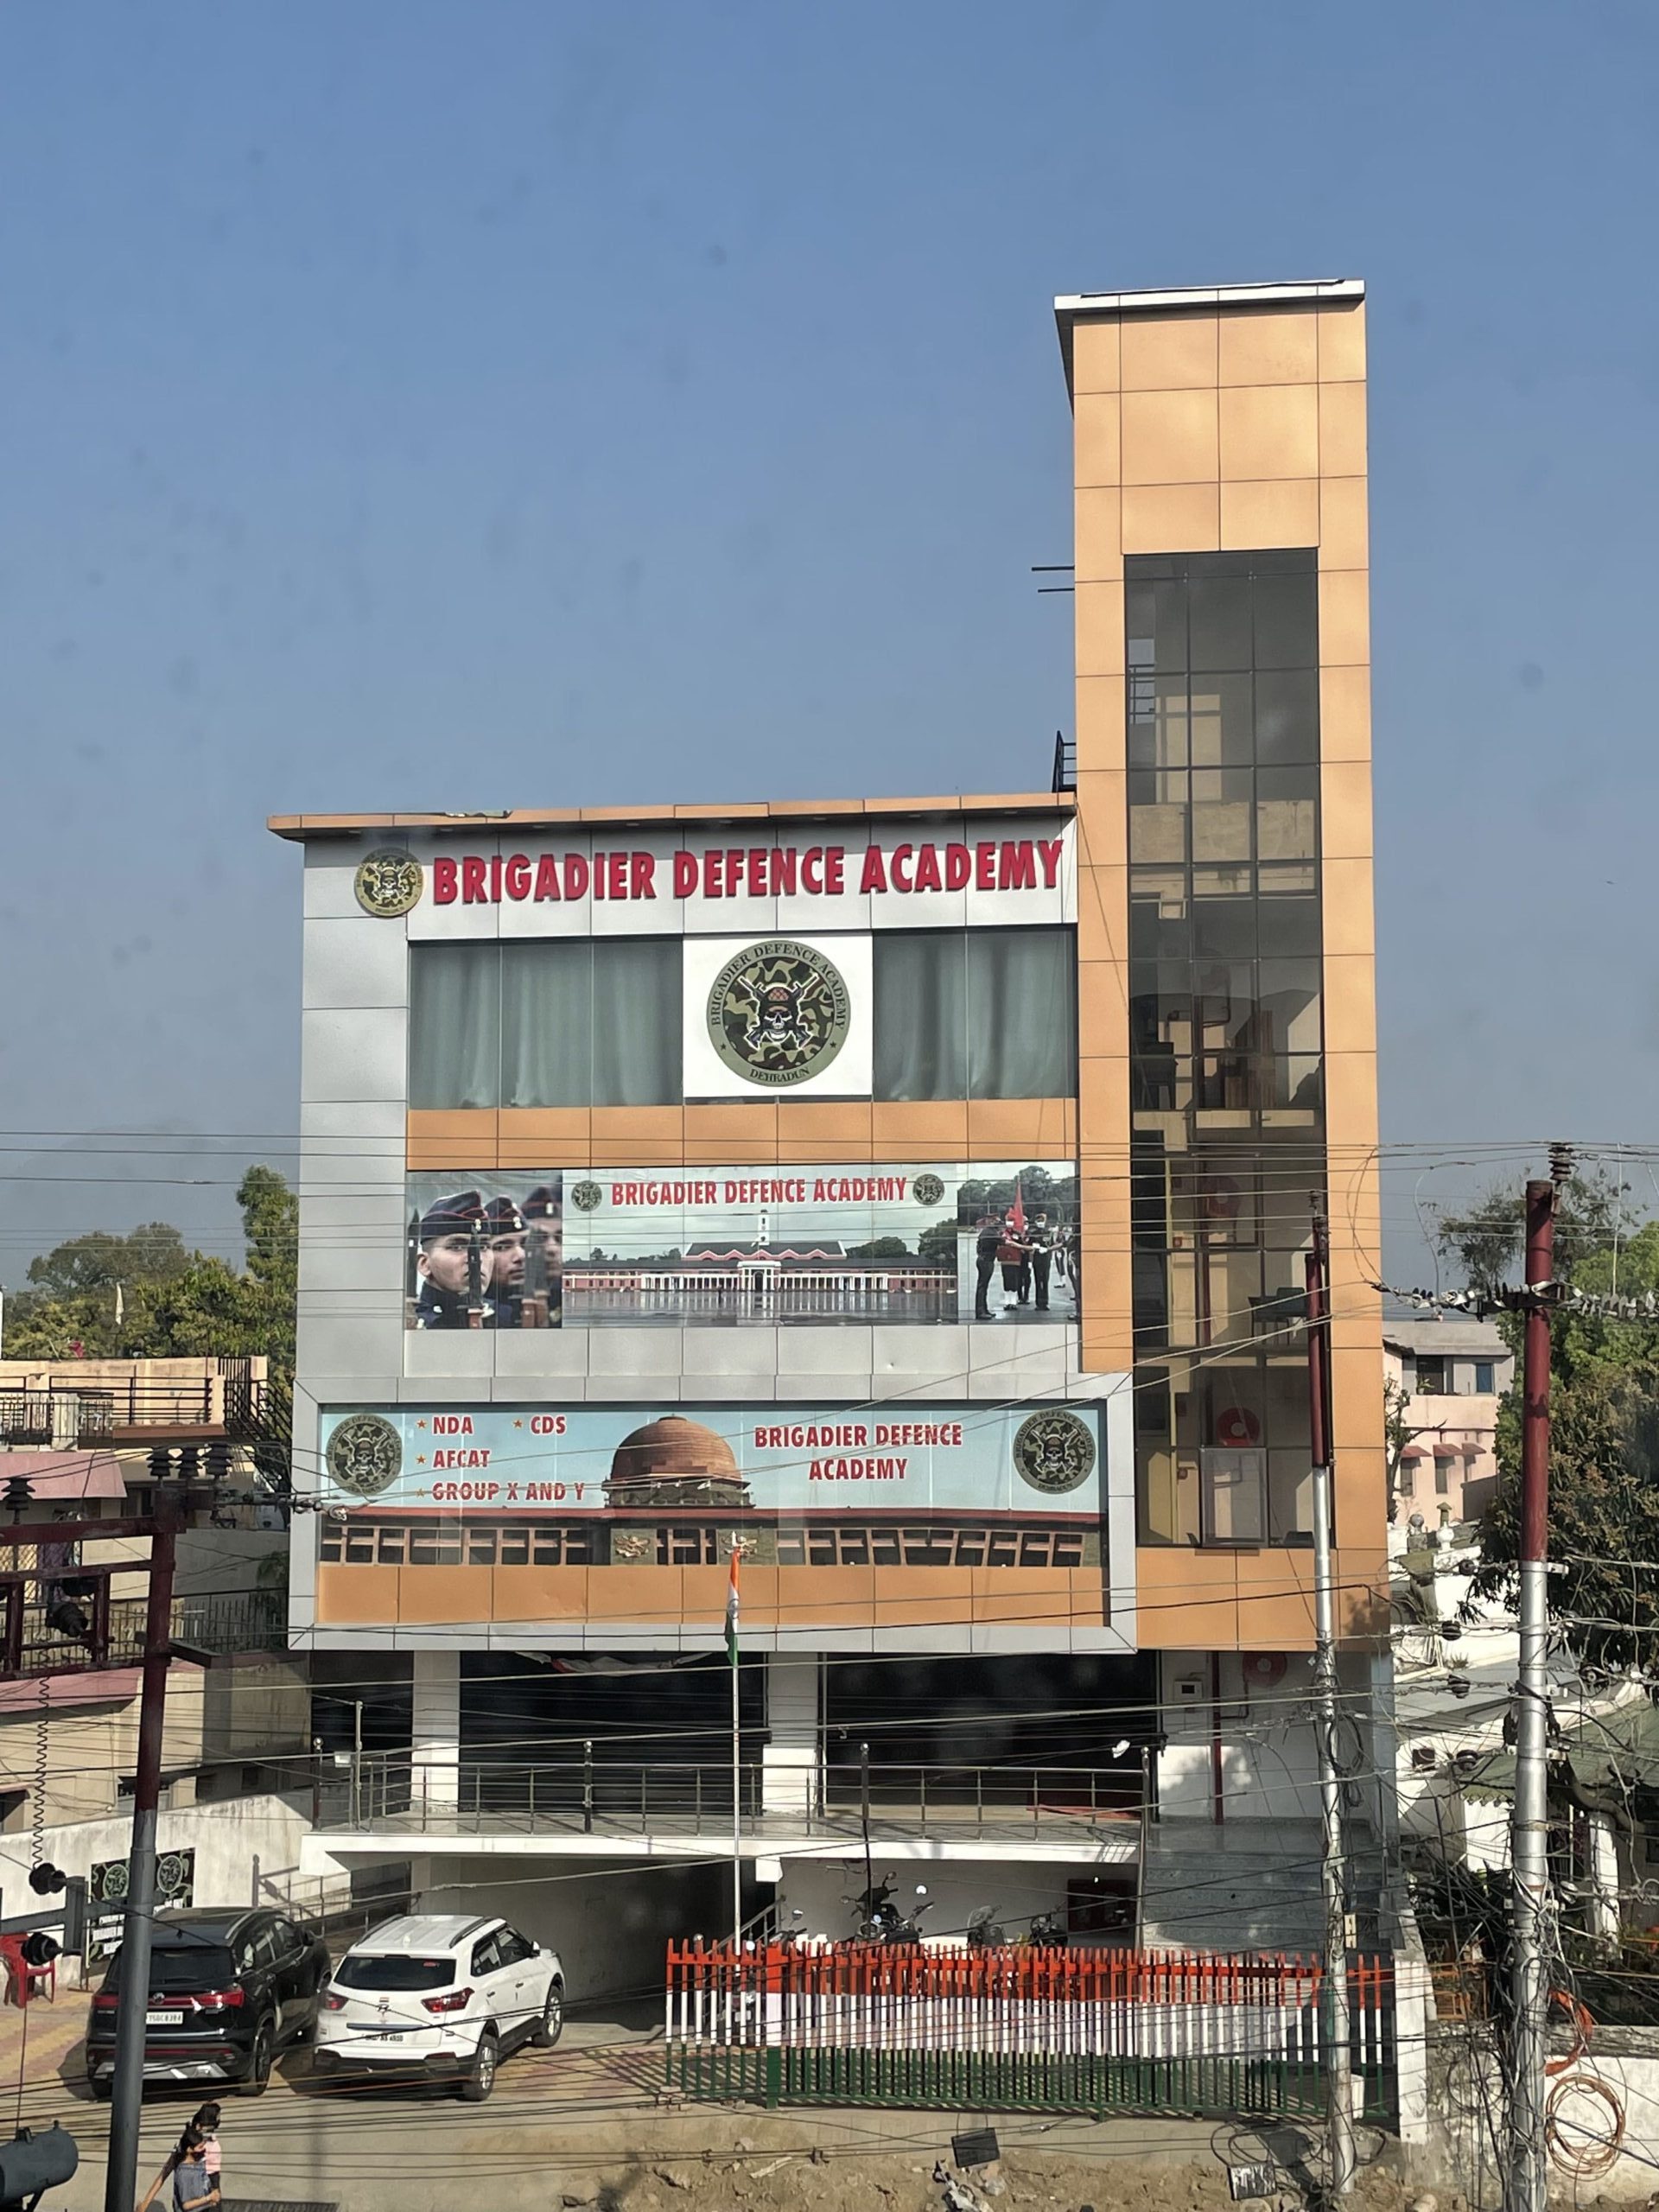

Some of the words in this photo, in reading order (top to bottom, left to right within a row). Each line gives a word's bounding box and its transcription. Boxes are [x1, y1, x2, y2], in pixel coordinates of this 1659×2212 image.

[434, 850, 657, 905] BRIGADIER
[673, 846, 845, 899] DEFENCE
[860, 839, 1064, 894] ACADEMY
[710, 954, 752, 1027] BRIGADIER
[753, 944, 819, 966] DEFENCE
[817, 959, 847, 1031] ACADEMY
[749, 1067, 810, 1083] DEHRADUN
[611, 1179, 718, 1206] BRIGADIER
[724, 1178, 806, 1204] DEFENCE
[813, 1176, 907, 1203] ACADEMY
[432, 1416, 474, 1434] NDA
[530, 1415, 567, 1434] CDS
[754, 1424, 868, 1447] BRIGADIER
[875, 1424, 963, 1446] DEFENCE
[432, 1449, 491, 1468] AFCAT
[809, 1458, 908, 1480] ACADEMY
[431, 1482, 499, 1501] GROUP
[506, 1482, 518, 1501] X
[525, 1482, 567, 1501] AND
[575, 1482, 586, 1501] Y
